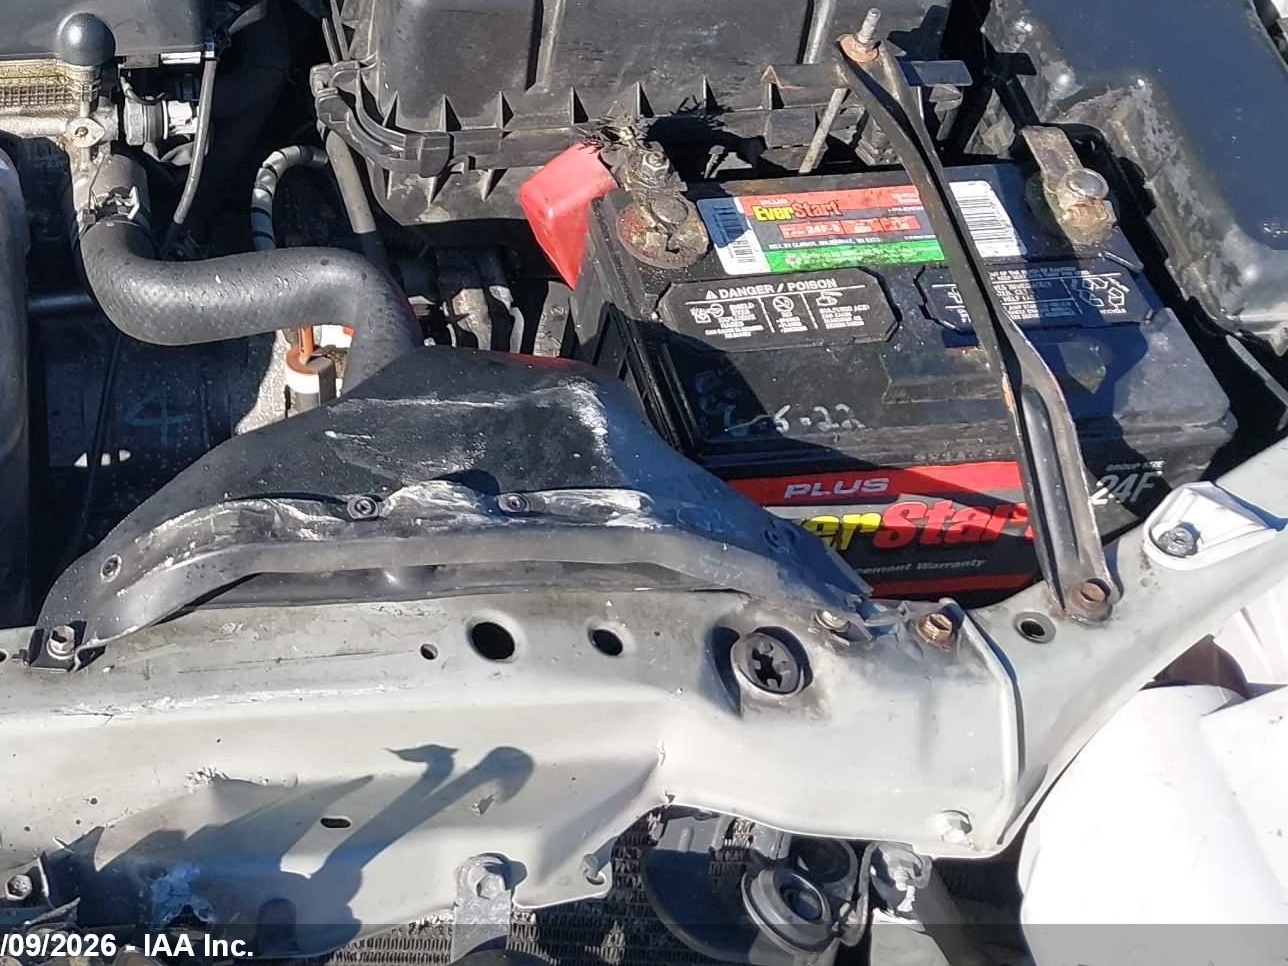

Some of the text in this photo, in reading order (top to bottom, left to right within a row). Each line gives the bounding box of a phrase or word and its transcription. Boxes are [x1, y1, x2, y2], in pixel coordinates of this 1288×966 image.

[751, 200, 843, 222] EverStart
[719, 284, 774, 299] DANGER
[787, 278, 838, 292] POISON
[784, 476, 891, 500] PLUS
[1089, 471, 1163, 505] 24F
[801, 500, 1035, 552] erStar
[915, 558, 987, 571] Warranty
